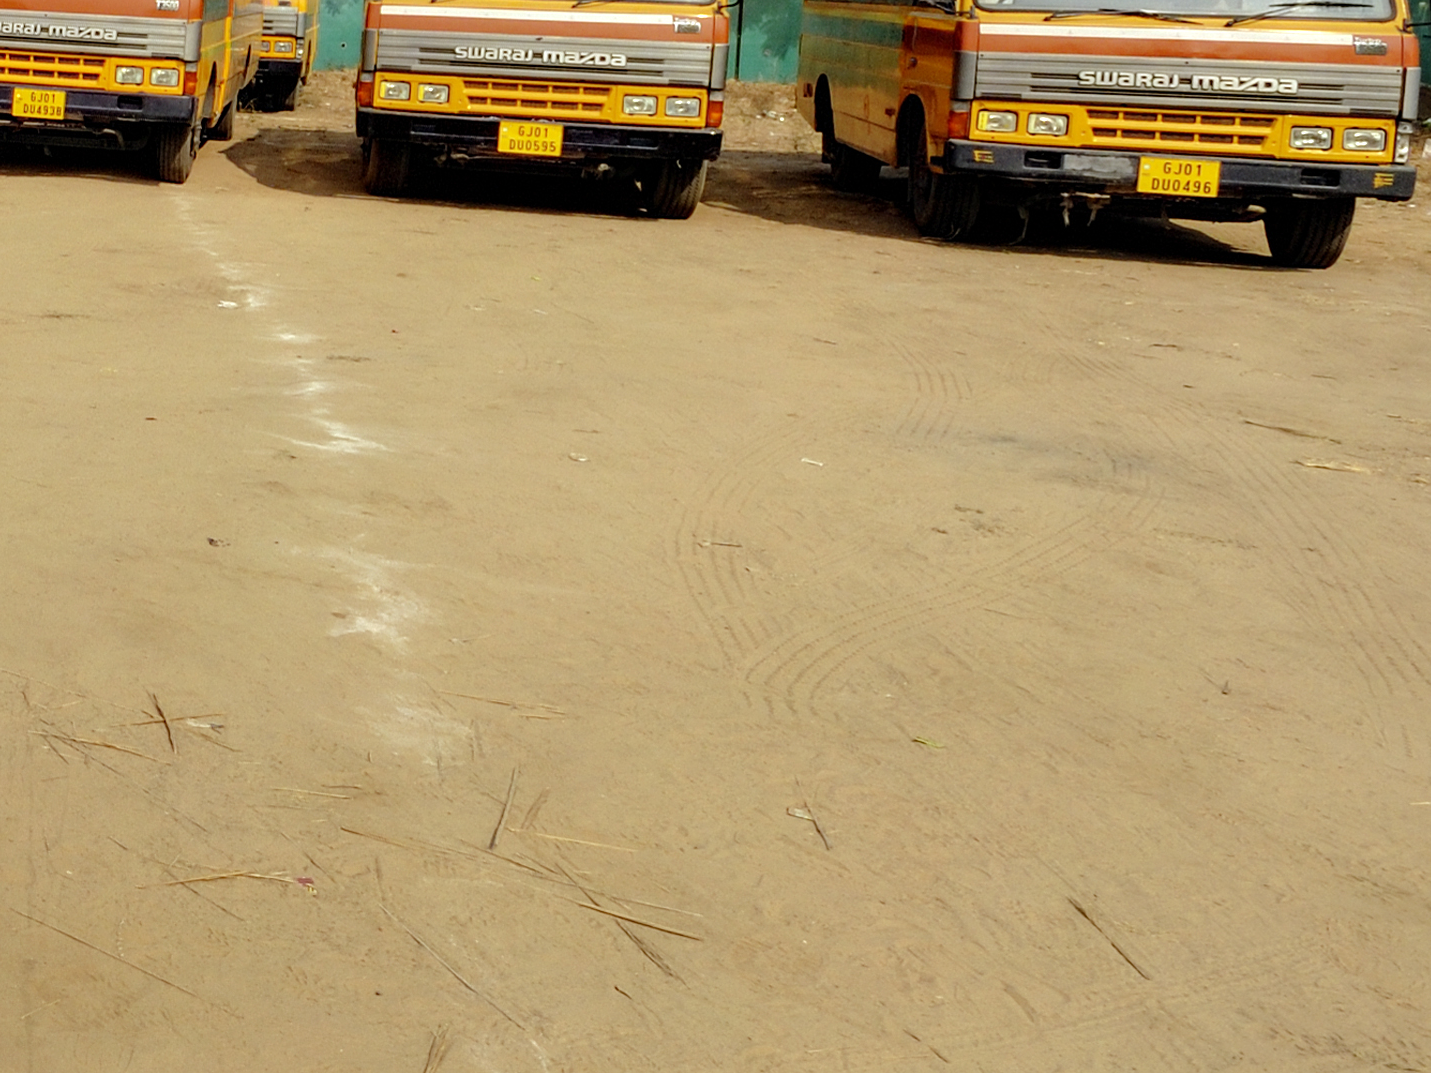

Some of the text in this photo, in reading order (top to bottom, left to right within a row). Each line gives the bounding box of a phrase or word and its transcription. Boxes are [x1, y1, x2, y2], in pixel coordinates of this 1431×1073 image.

[30, 91, 56, 104] GJ01
[23, 103, 62, 117] DU4938
[517, 125, 549, 138] GJ01
[509, 138, 557, 153] DU0595
[1163, 161, 1202, 177] GJ01
[1151, 177, 1212, 195] DU0496
